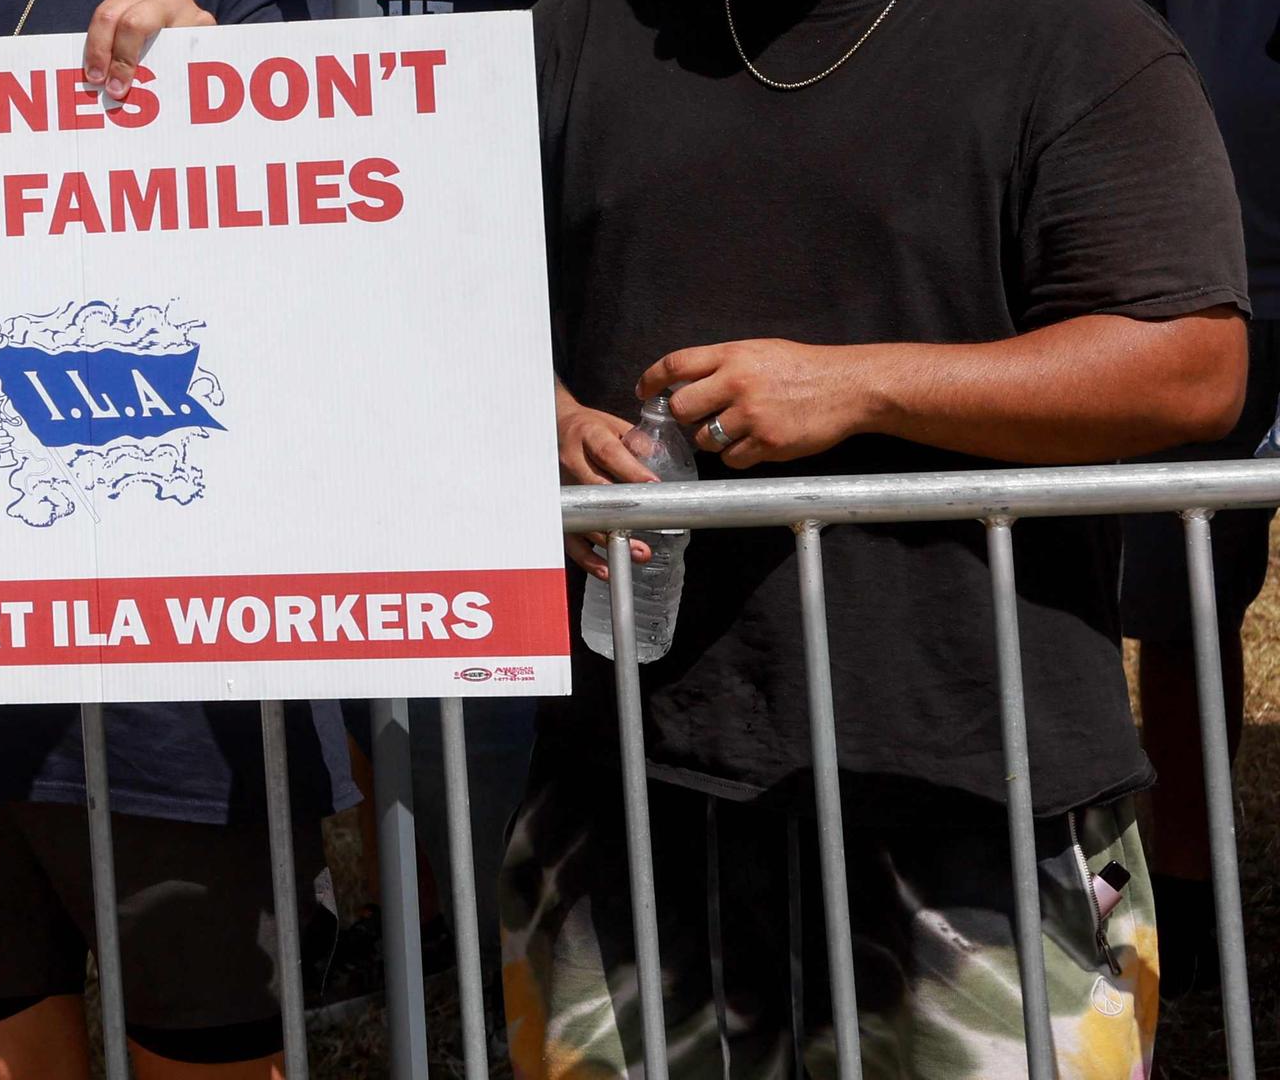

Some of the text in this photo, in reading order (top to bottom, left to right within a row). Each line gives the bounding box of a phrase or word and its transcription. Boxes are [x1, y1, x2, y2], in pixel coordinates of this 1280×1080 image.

[189, 50, 446, 124] DON'T
[4, 158, 404, 236] FAMILIES
[23, 368, 191, 421] I.L.A.
[51, 598, 151, 648] ILA
[164, 591, 494, 645] WORKERS
